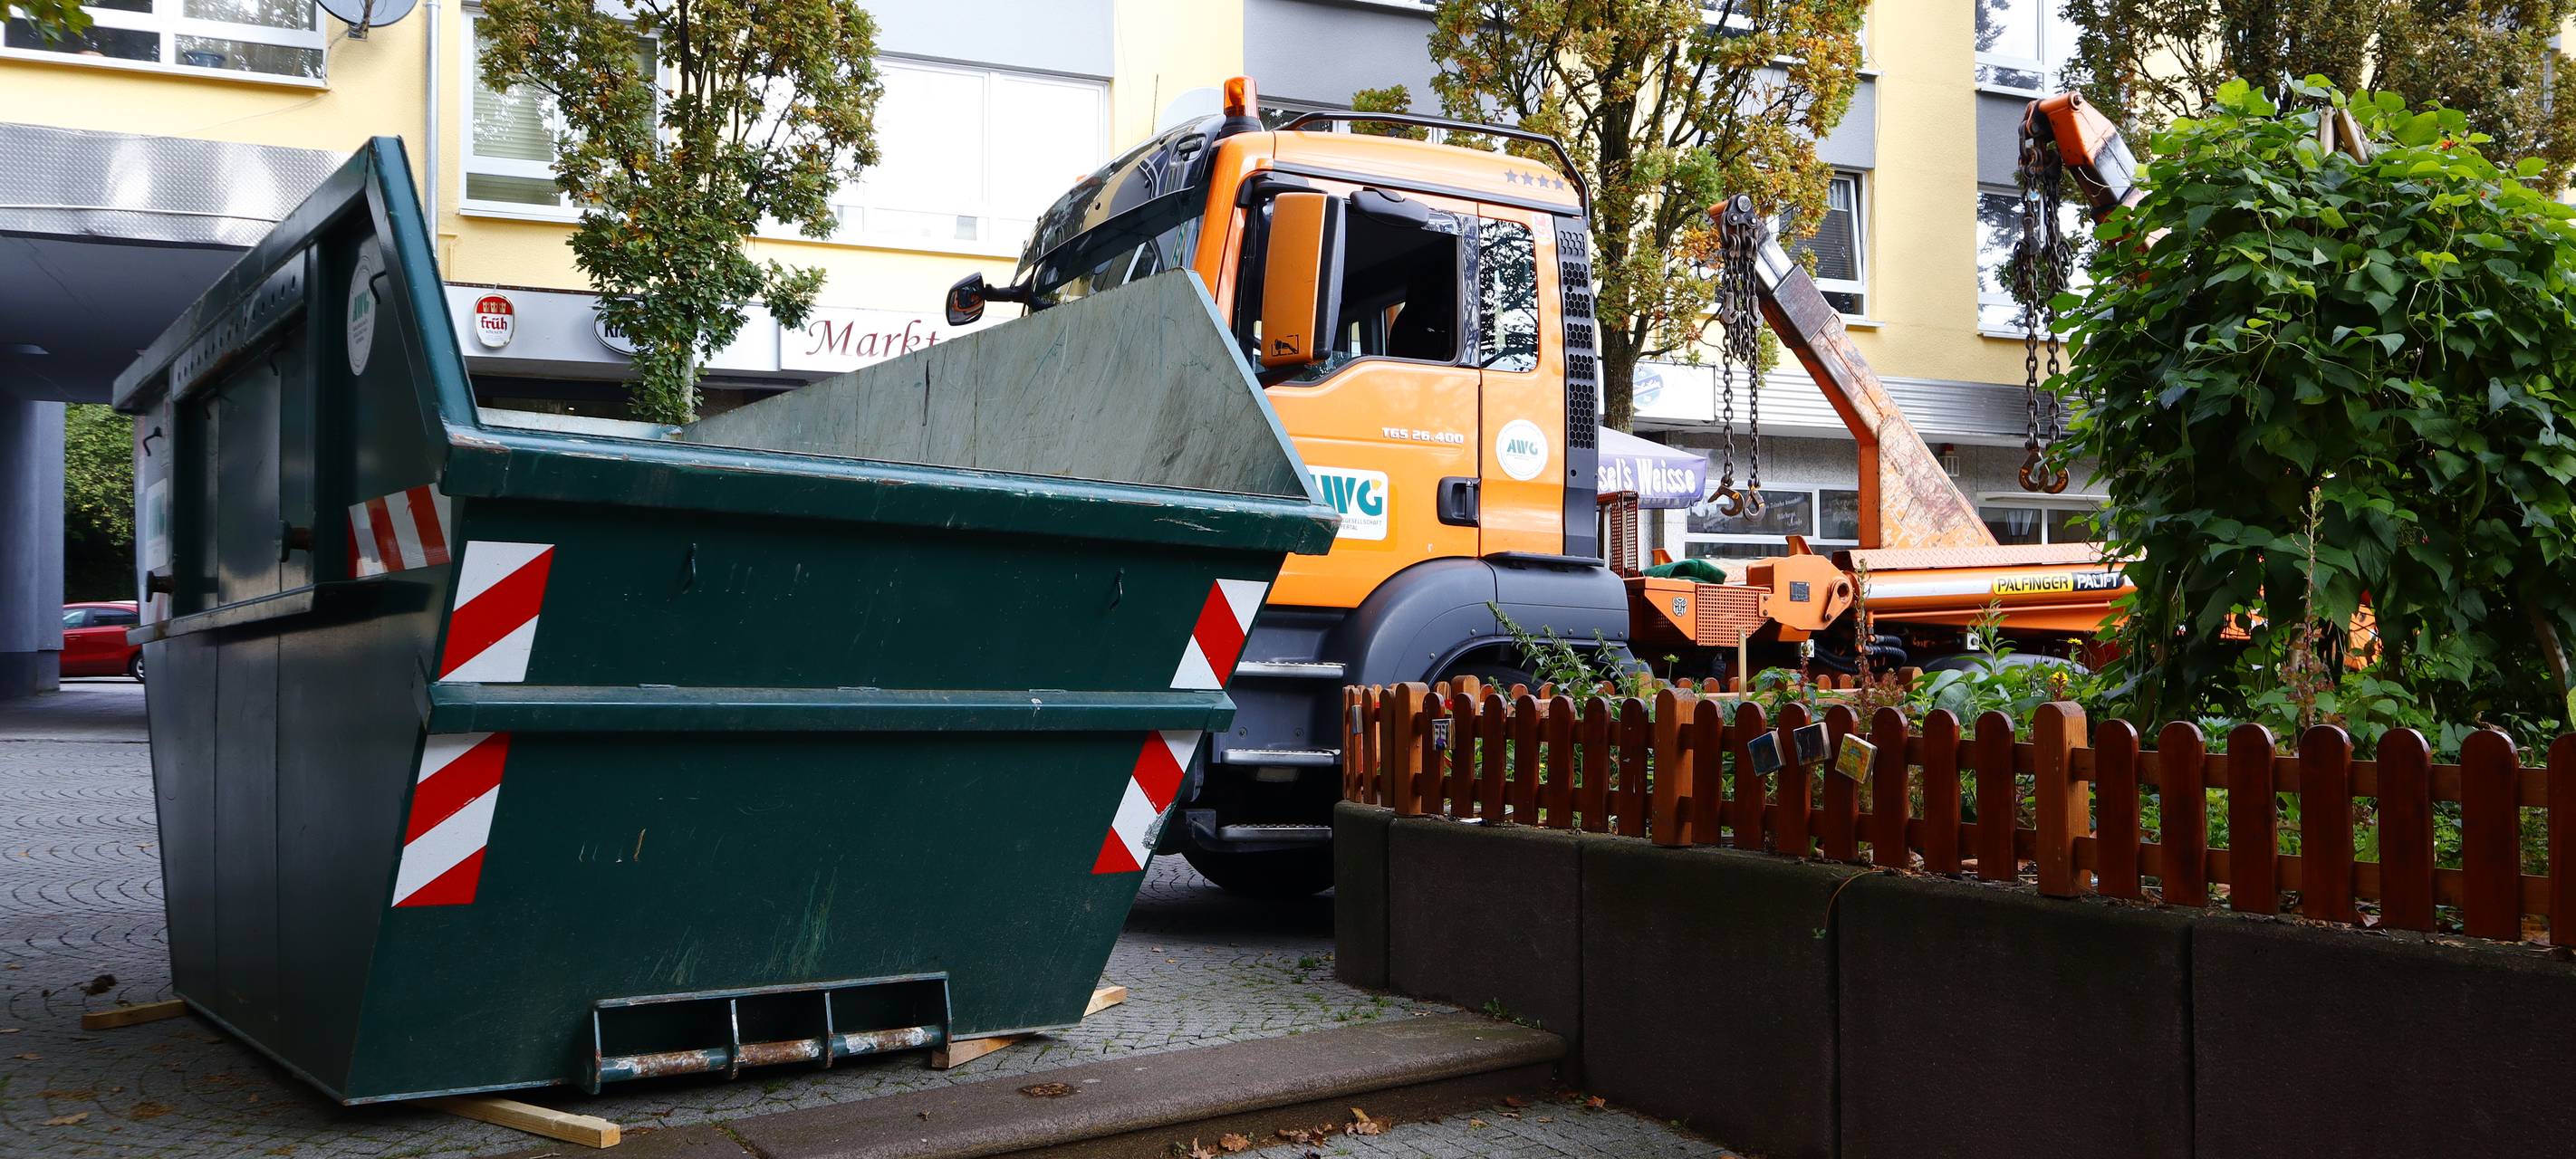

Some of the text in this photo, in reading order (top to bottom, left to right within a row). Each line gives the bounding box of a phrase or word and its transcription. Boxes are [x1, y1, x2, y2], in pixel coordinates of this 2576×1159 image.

[481, 316, 507, 330] früh
[1382, 427, 1465, 444] TGS 26.400
[1506, 438, 1539, 455] AWG
[1635, 458, 1697, 495] Weisse
[1997, 576, 2069, 592] PALFINGER
